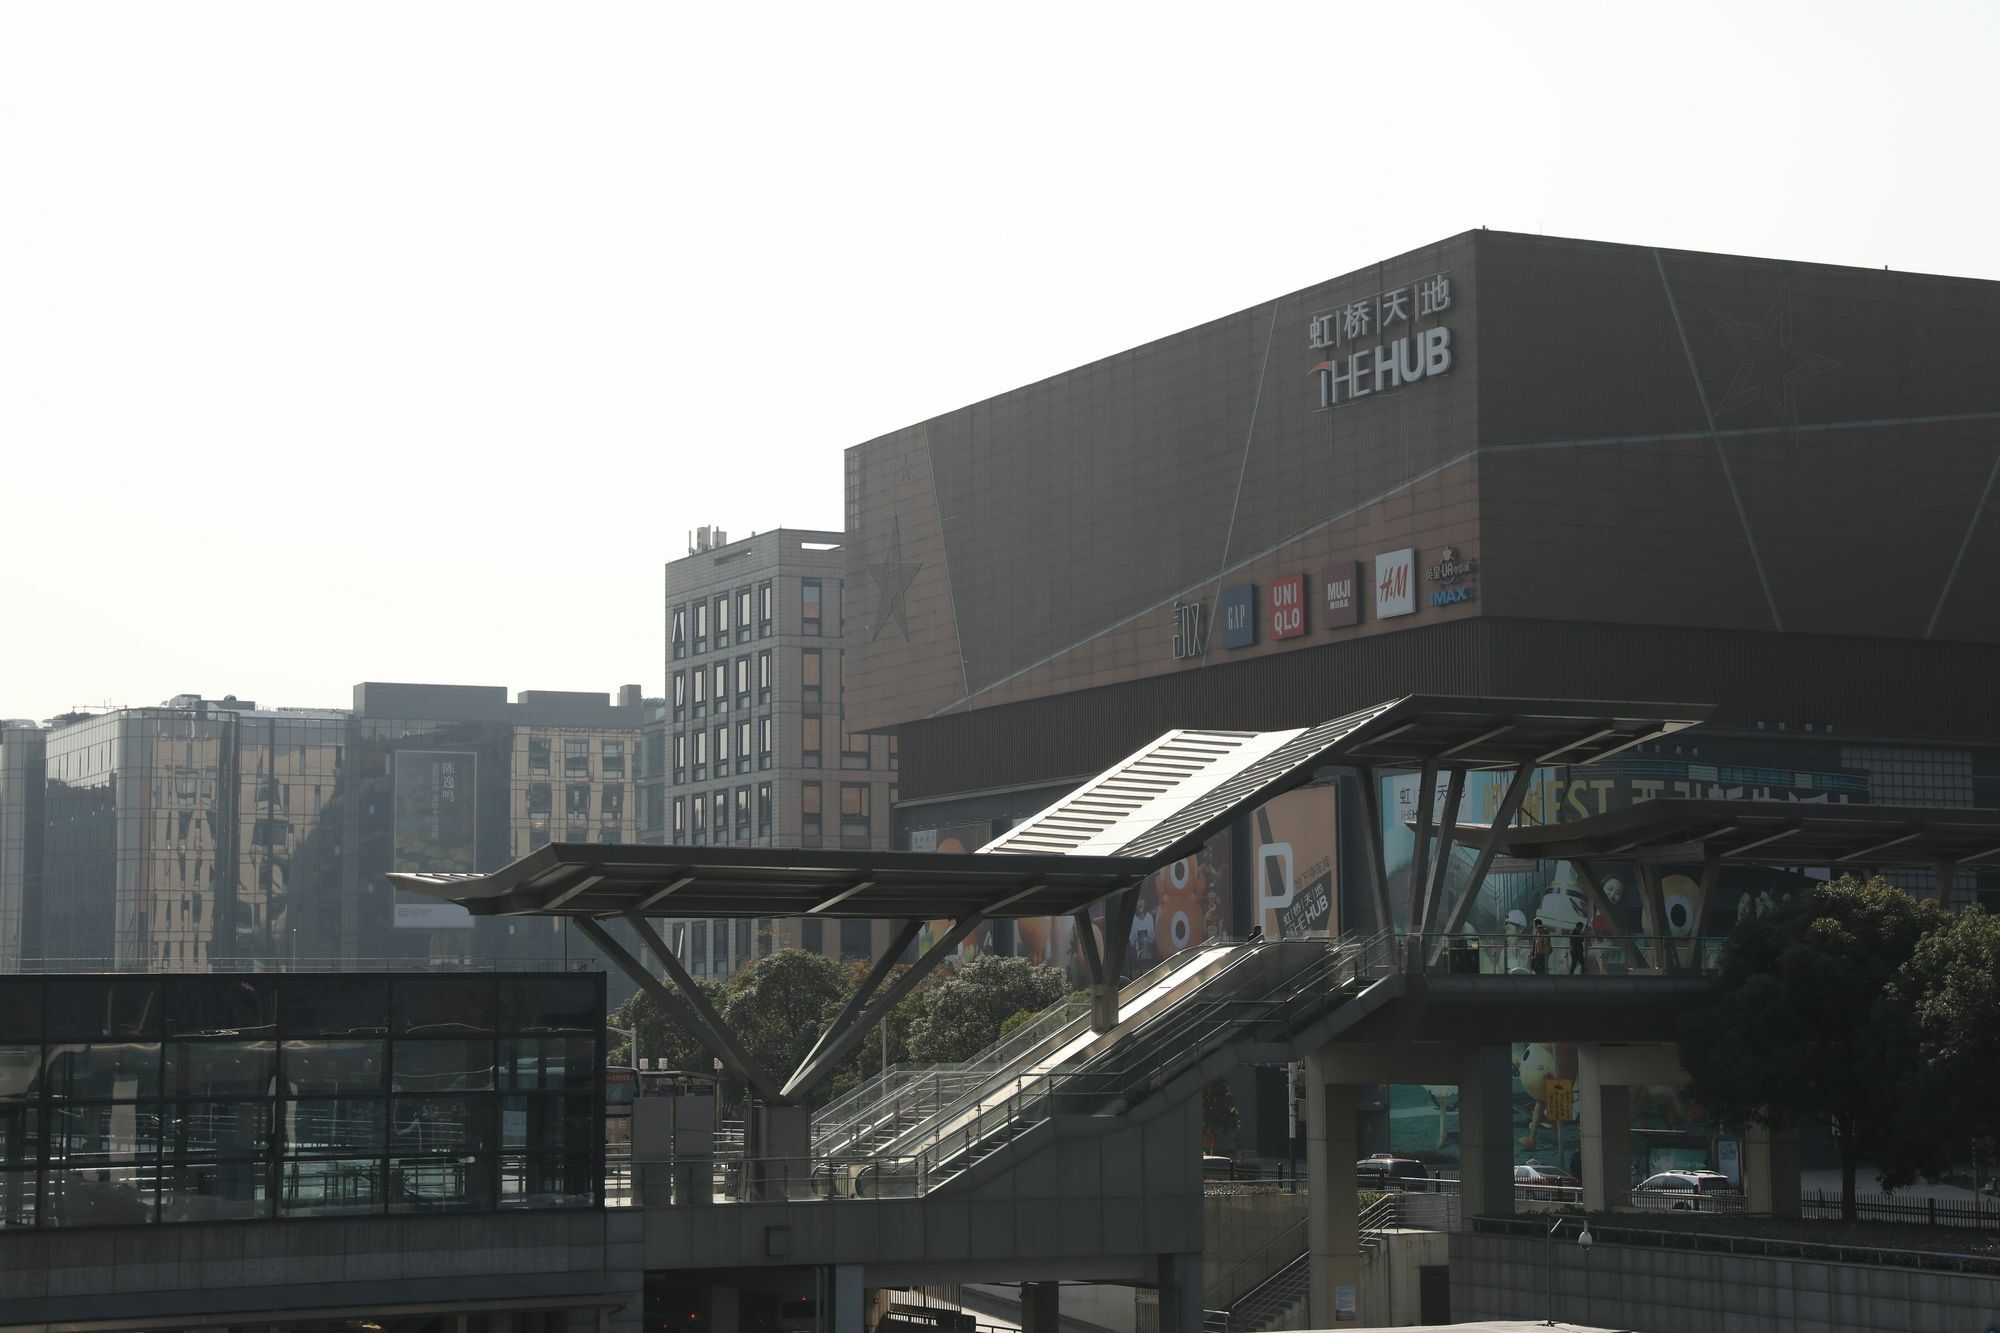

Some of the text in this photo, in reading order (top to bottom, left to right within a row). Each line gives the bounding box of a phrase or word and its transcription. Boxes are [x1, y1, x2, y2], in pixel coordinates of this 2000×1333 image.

[1308, 326, 1453, 408] THE HUB
[1273, 582, 1298, 607] UNI
[1327, 579, 1351, 601] MUJI
[1379, 564, 1409, 603] H&M
[1429, 585, 1468, 607] IMAX
[1227, 604, 1246, 631] GAP
[1273, 608, 1300, 636] QLO
[1258, 842, 1294, 937] P
[1305, 894, 1329, 924] HUB
